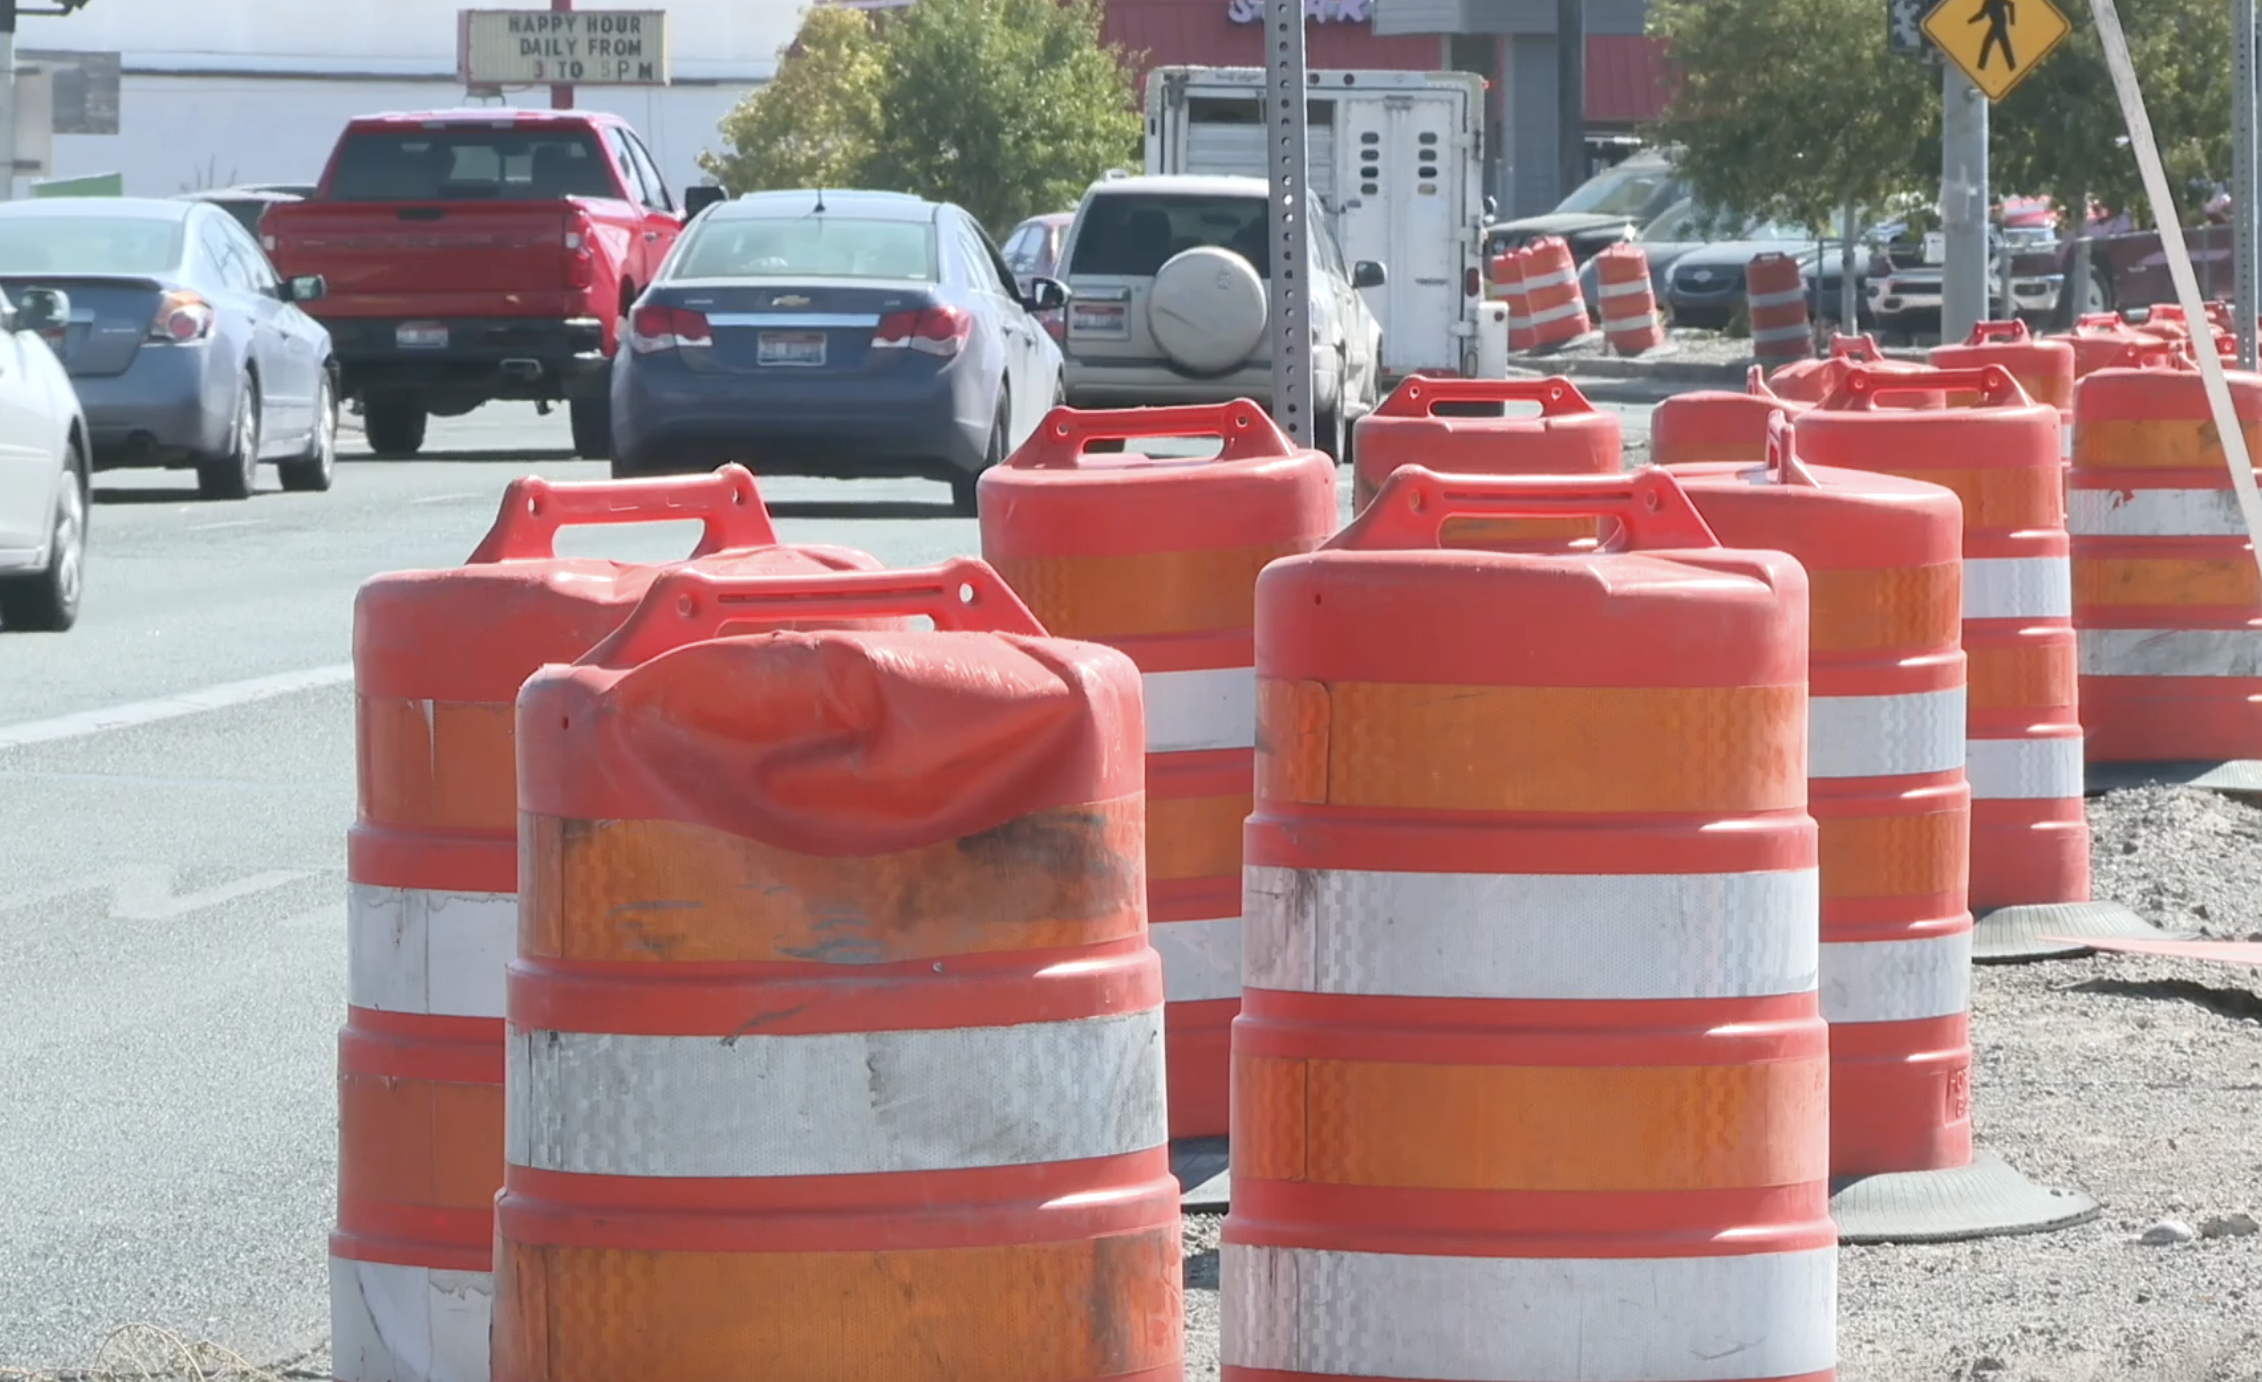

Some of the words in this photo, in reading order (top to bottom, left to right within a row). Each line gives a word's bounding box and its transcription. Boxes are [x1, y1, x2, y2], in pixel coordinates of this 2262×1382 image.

[508, 15, 577, 33] HAPPY
[586, 15, 641, 34] HOUR
[519, 38, 577, 56] DAILY
[588, 38, 641, 56] FROM
[533, 60, 544, 79] 3
[557, 60, 584, 79] TO
